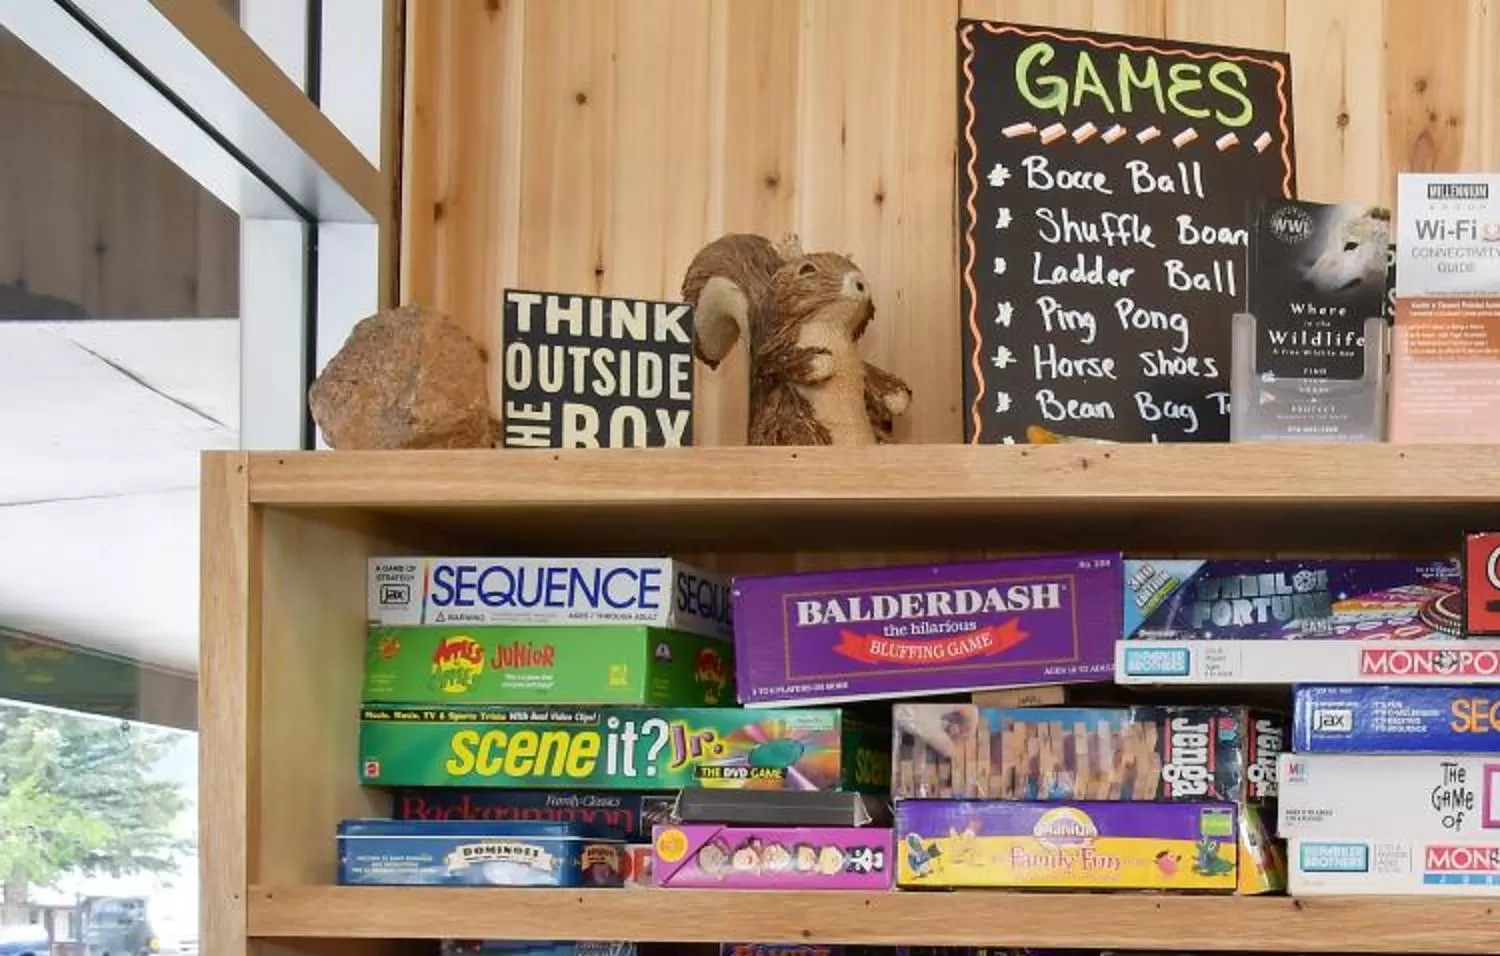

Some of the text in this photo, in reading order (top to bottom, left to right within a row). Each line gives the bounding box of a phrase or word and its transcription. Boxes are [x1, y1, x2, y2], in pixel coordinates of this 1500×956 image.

[1015, 42, 1254, 127] GAMES
[1022, 156, 1204, 199] Bocce Ball
[1035, 208, 1156, 249] Shuffle
[1415, 219, 1477, 241] Wi-Fi
[1033, 252, 1236, 296] Ladder Ball
[507, 293, 691, 343] THINK
[1037, 298, 1189, 352] Ping Pong
[1290, 302, 1347, 316] Where
[1268, 329, 1365, 347] Wildlife
[506, 341, 691, 400] OUTSIDE
[1034, 345, 1218, 381] Horse Shoes
[1039, 392, 1198, 433] Bean Bag
[432, 565, 662, 609] SEQUENCE
[796, 582, 1062, 627] BALDERDASH
[869, 633, 994, 661] BLUFFING GAME
[883, 619, 978, 637] the hilarious
[446, 716, 669, 777] scene it?
[723, 767, 748, 778] DVD
